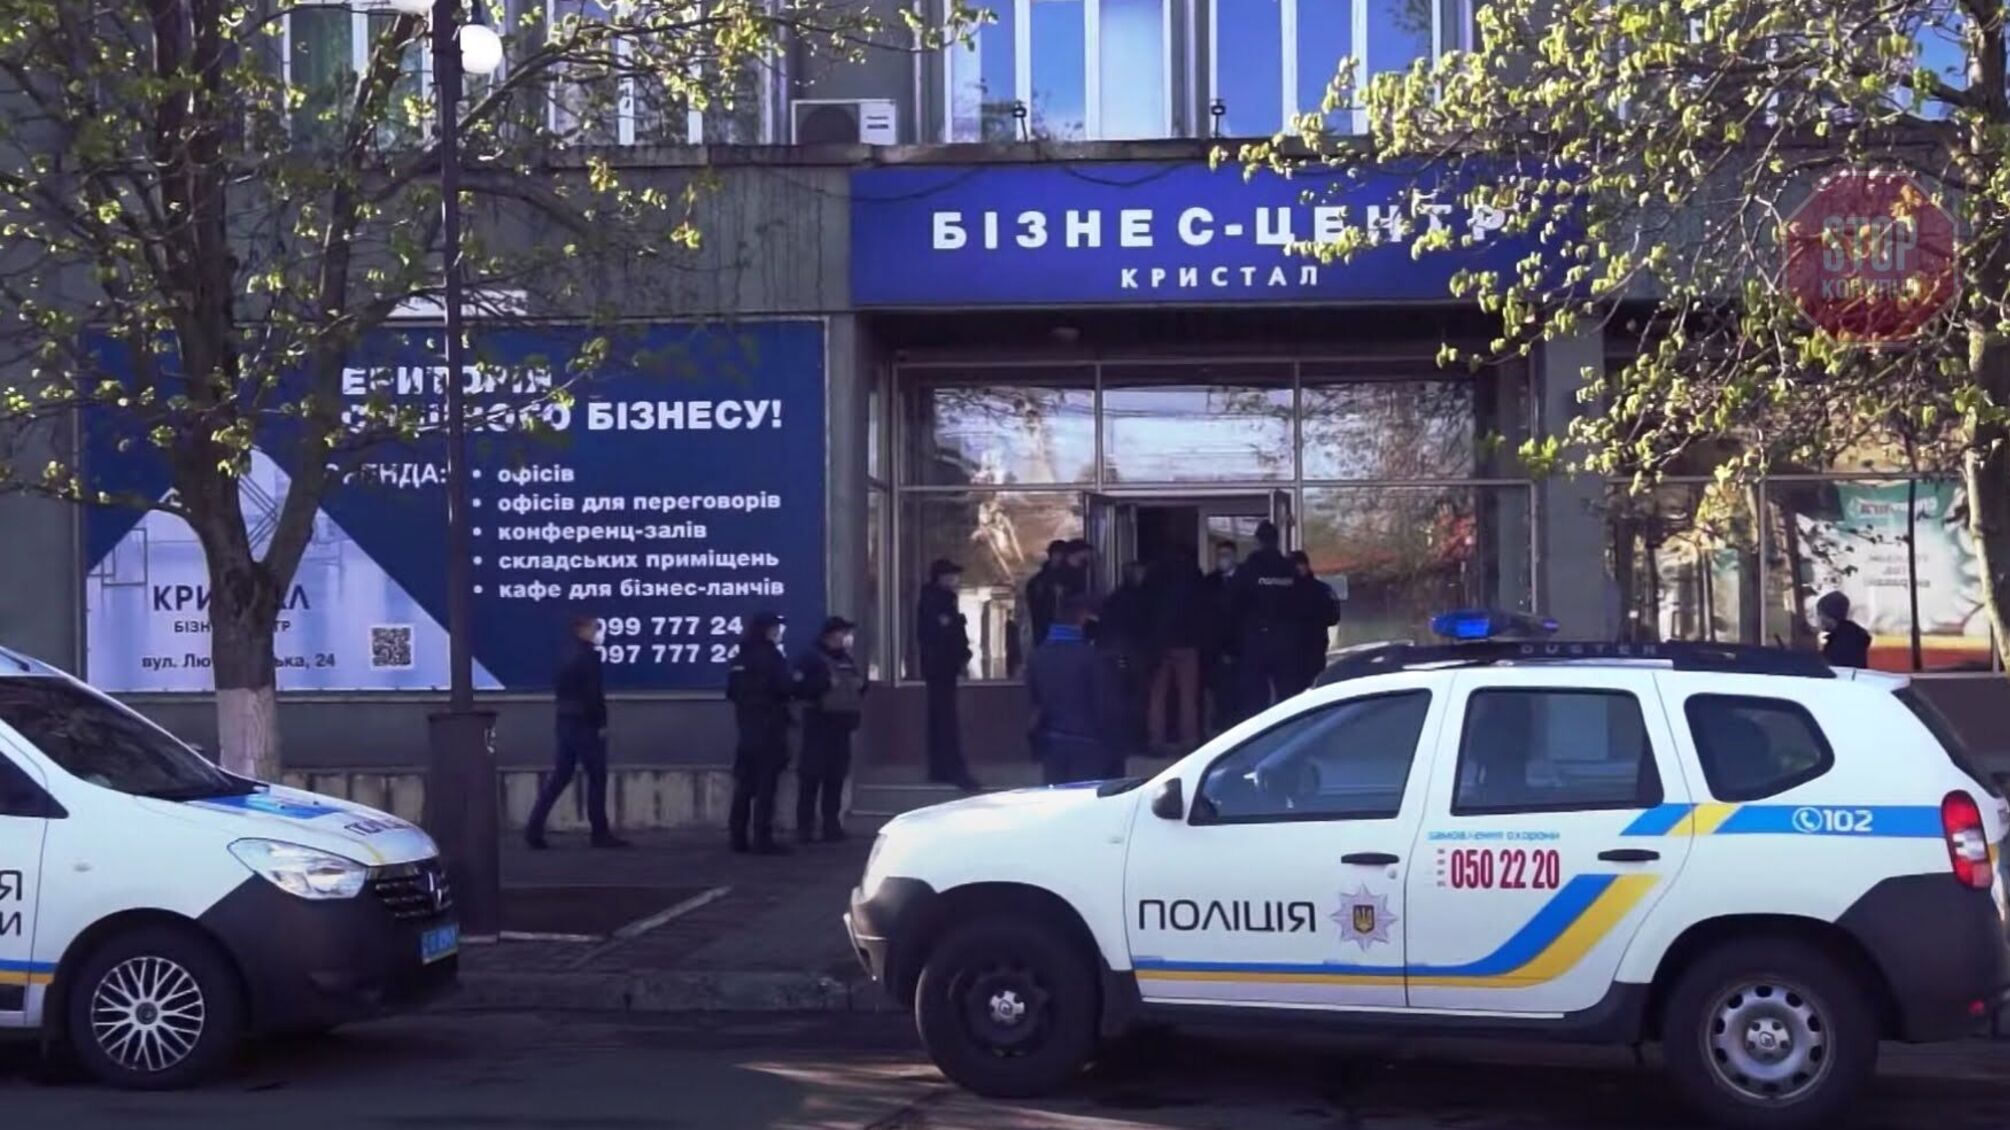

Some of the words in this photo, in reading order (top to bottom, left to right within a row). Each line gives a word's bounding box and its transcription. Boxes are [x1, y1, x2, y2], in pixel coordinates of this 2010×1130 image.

[933, 205, 1505, 250] БІЗНЕС-ЦЕНТР
[1121, 265, 1318, 288] КРИСТАЛ
[587, 400, 783, 430] БІЗНЕСУ!
[498, 465, 575, 486] офісів
[498, 494, 575, 514] офісів
[582, 496, 625, 513] для
[633, 491, 782, 513] переговорів
[498, 521, 708, 543] конференц-залів
[499, 554, 638, 571] складських
[646, 549, 780, 571] приміщень
[499, 580, 562, 601] кафе
[569, 583, 612, 600] для
[620, 578, 785, 598] бізнес-ланчів
[651, 616, 700, 635] 777
[710, 616, 744, 635] 24
[142, 655, 177, 670] вул.
[315, 653, 336, 668] 24
[651, 644, 700, 664] 777
[1822, 809, 1873, 832] 102
[1451, 849, 1494, 889] 050
[1500, 849, 1526, 889] 22
[1532, 849, 1560, 889] 20
[1139, 899, 1316, 932] ПОЛІЦІЯ
